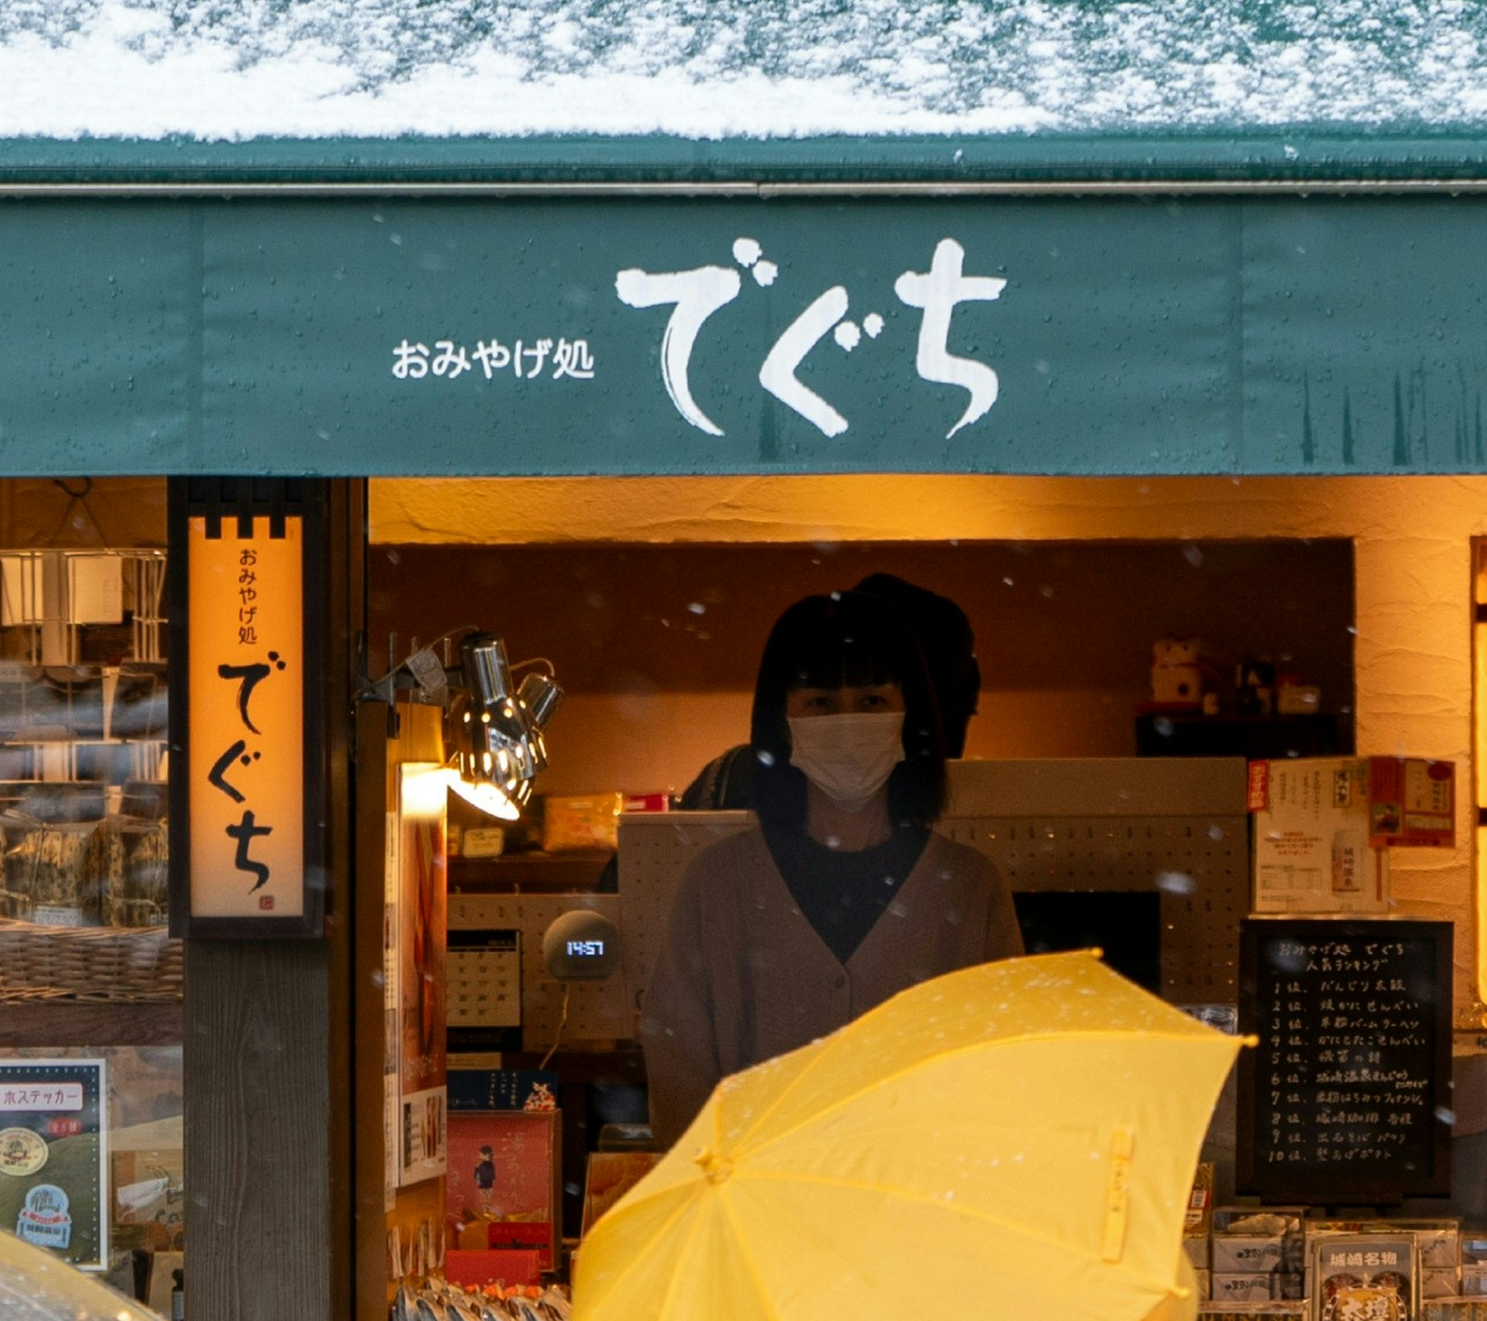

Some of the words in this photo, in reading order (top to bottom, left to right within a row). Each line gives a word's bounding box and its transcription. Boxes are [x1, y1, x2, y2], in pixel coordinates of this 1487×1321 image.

[390, 338, 596, 380] おみやげ処
[613, 236, 1009, 441] でぐち
[237, 548, 257, 645] おみやげ処
[207, 650, 287, 895] でぐち
[566, 940, 605, 957] 14:57
[1279, 942, 1352, 956] おみやげ処
[1364, 943, 1405, 956] でぐち
[1306, 959, 1389, 971] 人気ランキング
[1329, 1251, 1398, 1268] 城崎名物
